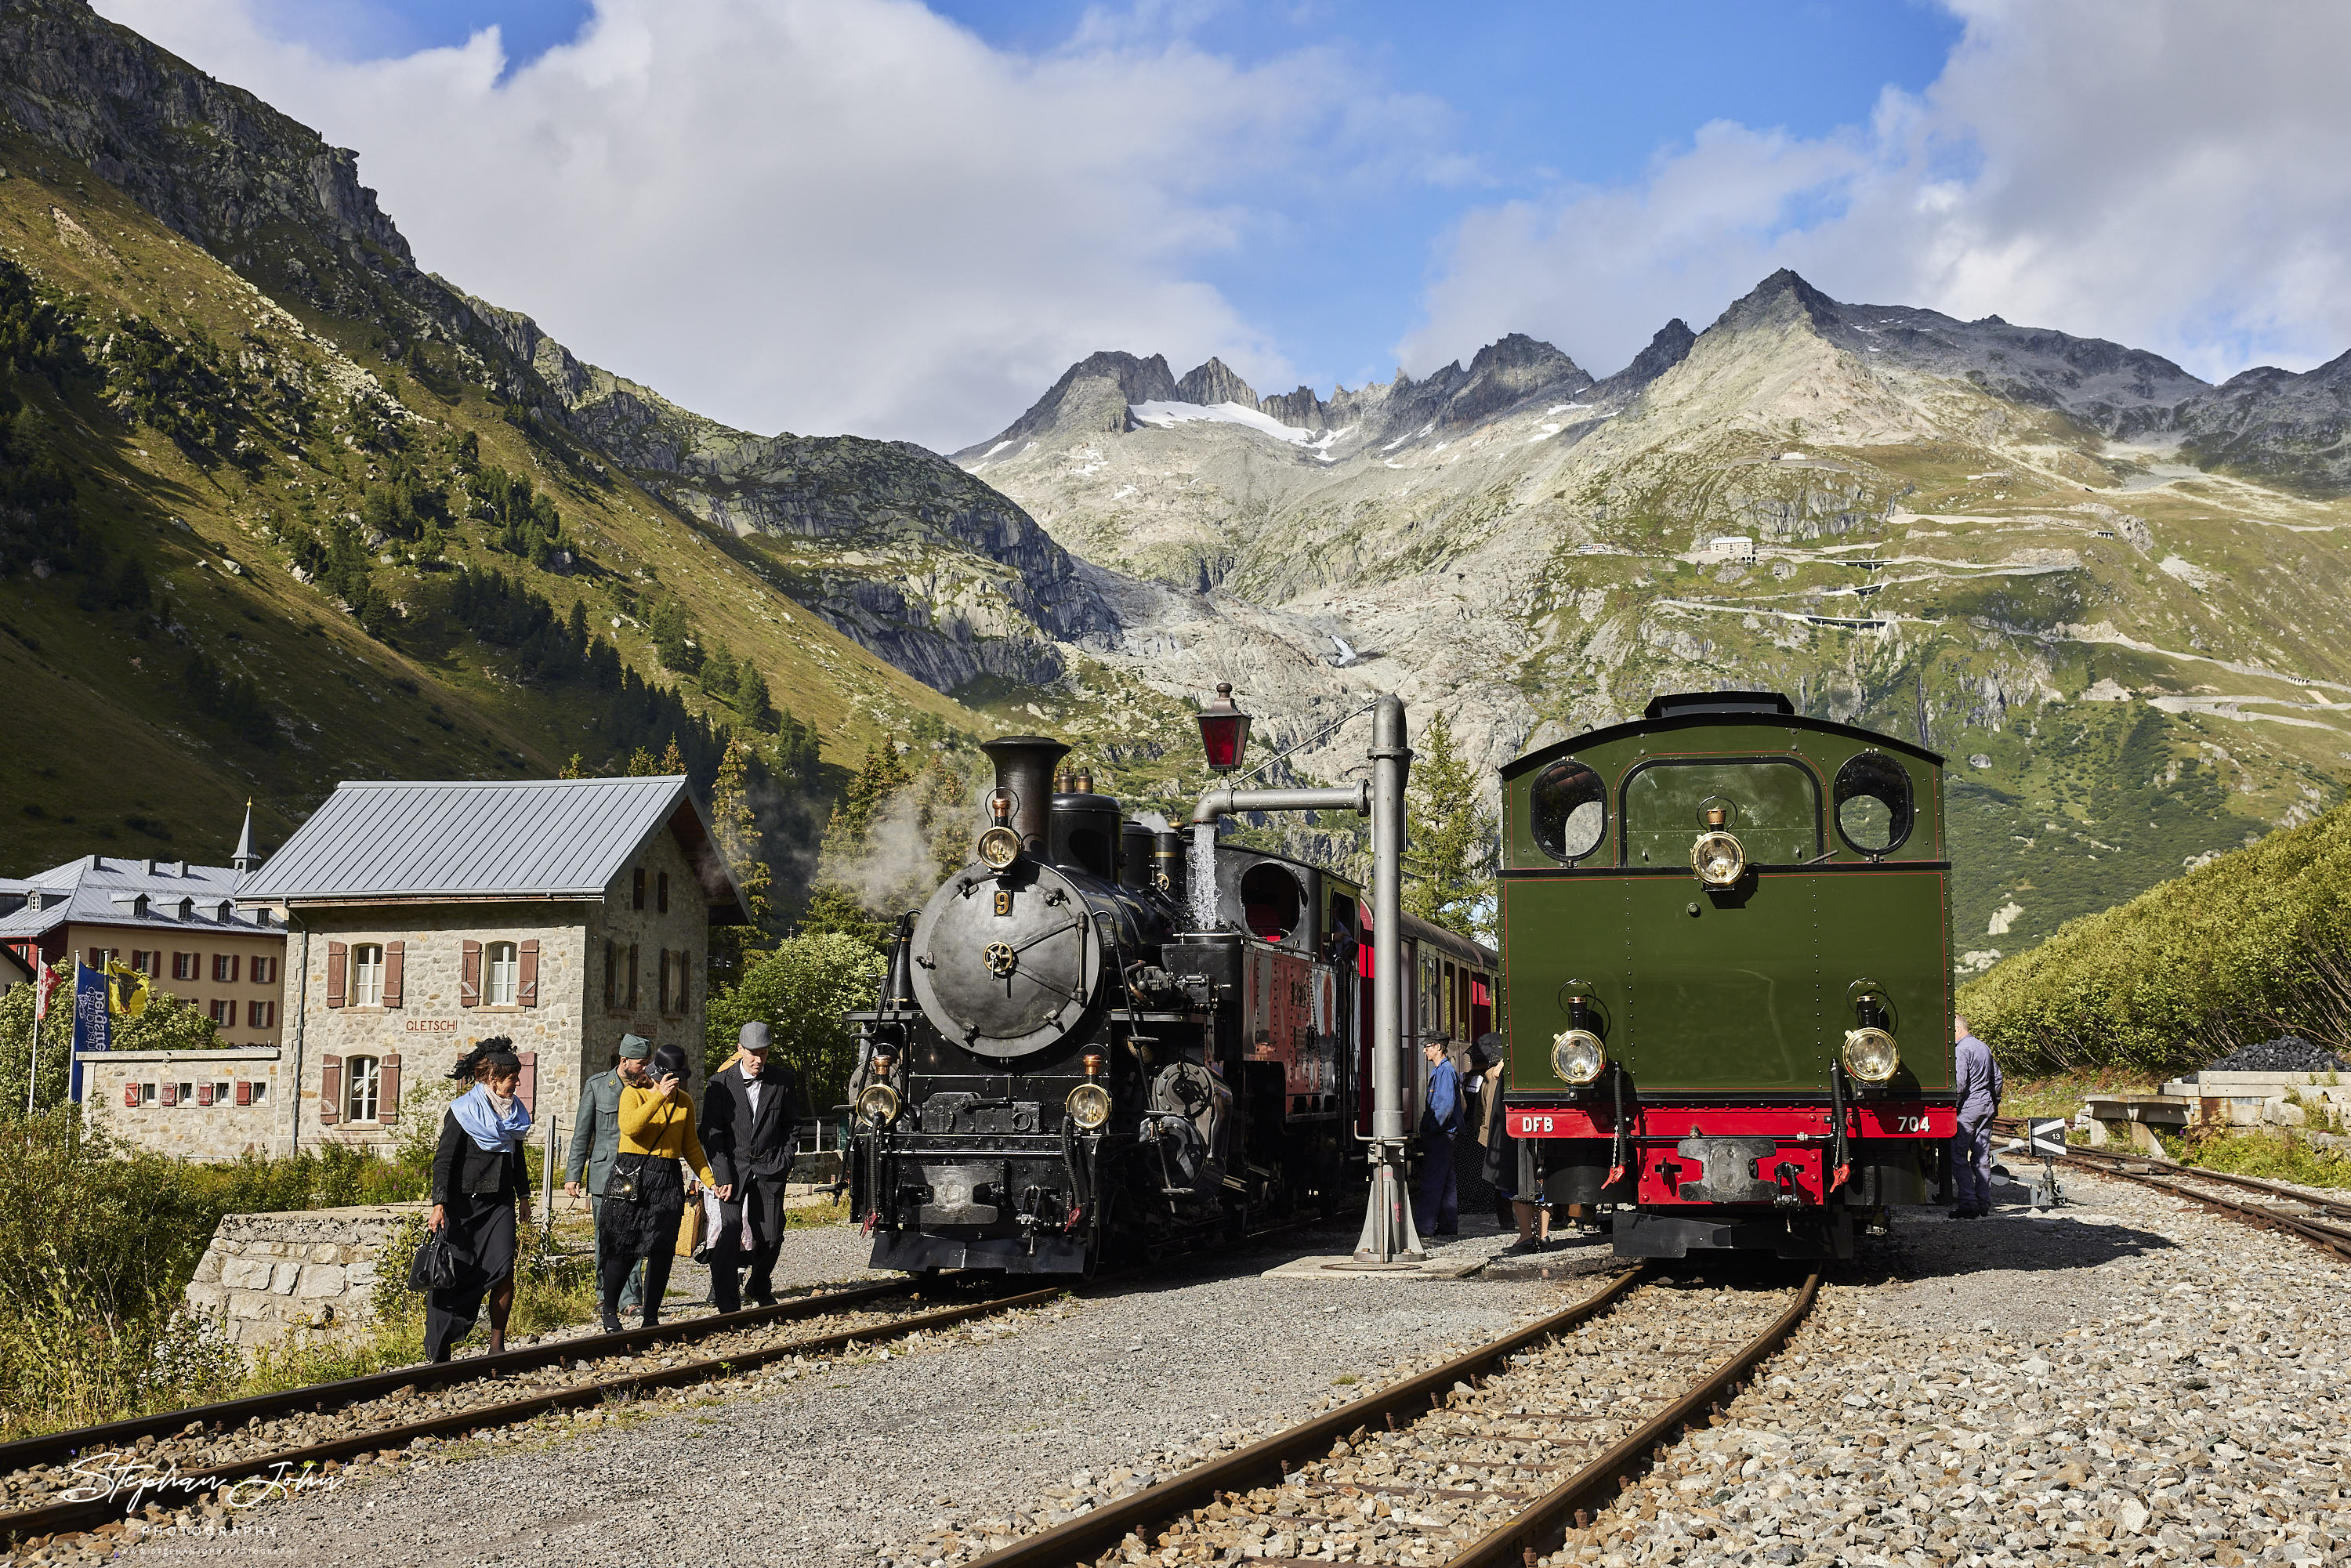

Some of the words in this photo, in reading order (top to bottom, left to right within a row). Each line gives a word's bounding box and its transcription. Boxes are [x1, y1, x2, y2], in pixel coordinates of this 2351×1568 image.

[995, 892, 1009, 914] 9
[406, 1020, 455, 1031] GLETSCH
[636, 1023, 657, 1034] GLETSCH
[1522, 1117, 1554, 1132] DFB
[1897, 1116, 1930, 1132] 704
